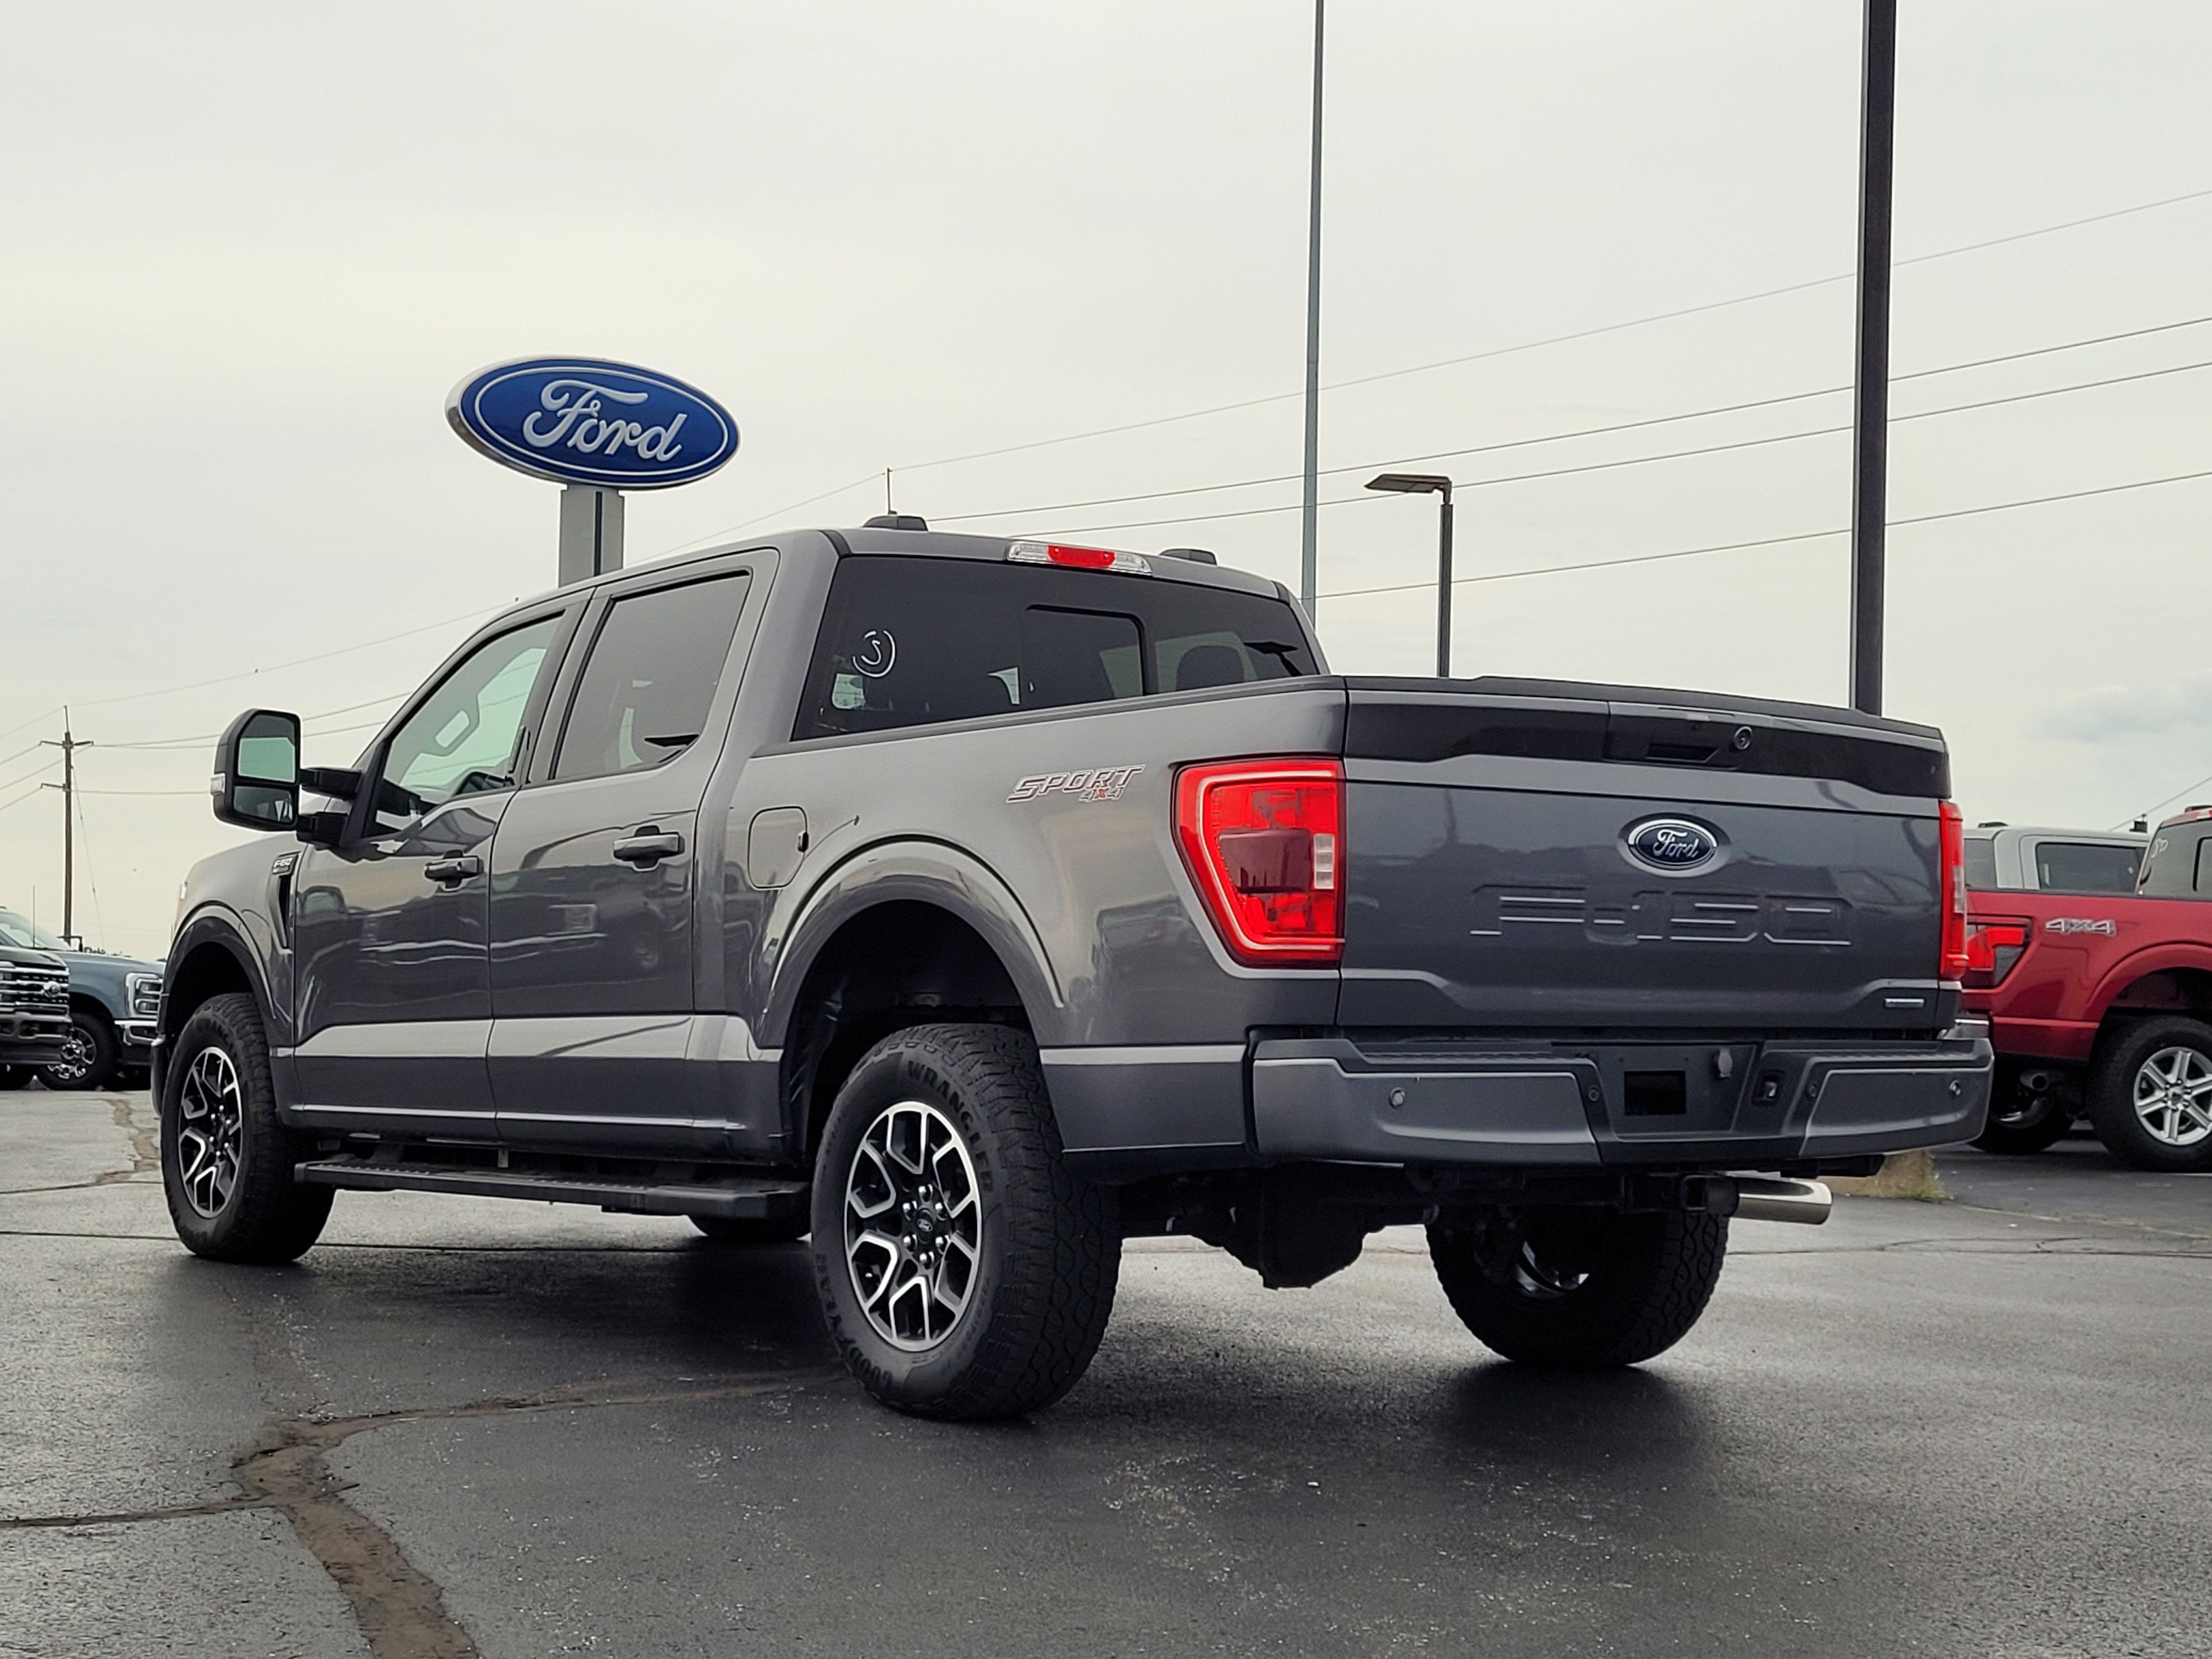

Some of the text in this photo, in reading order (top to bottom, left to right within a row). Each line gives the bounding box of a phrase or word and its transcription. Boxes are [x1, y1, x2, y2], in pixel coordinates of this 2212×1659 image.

[522, 379, 687, 461] Ford
[1006, 764, 1146, 803] SPORT
[1653, 829, 1699, 858] Ford
